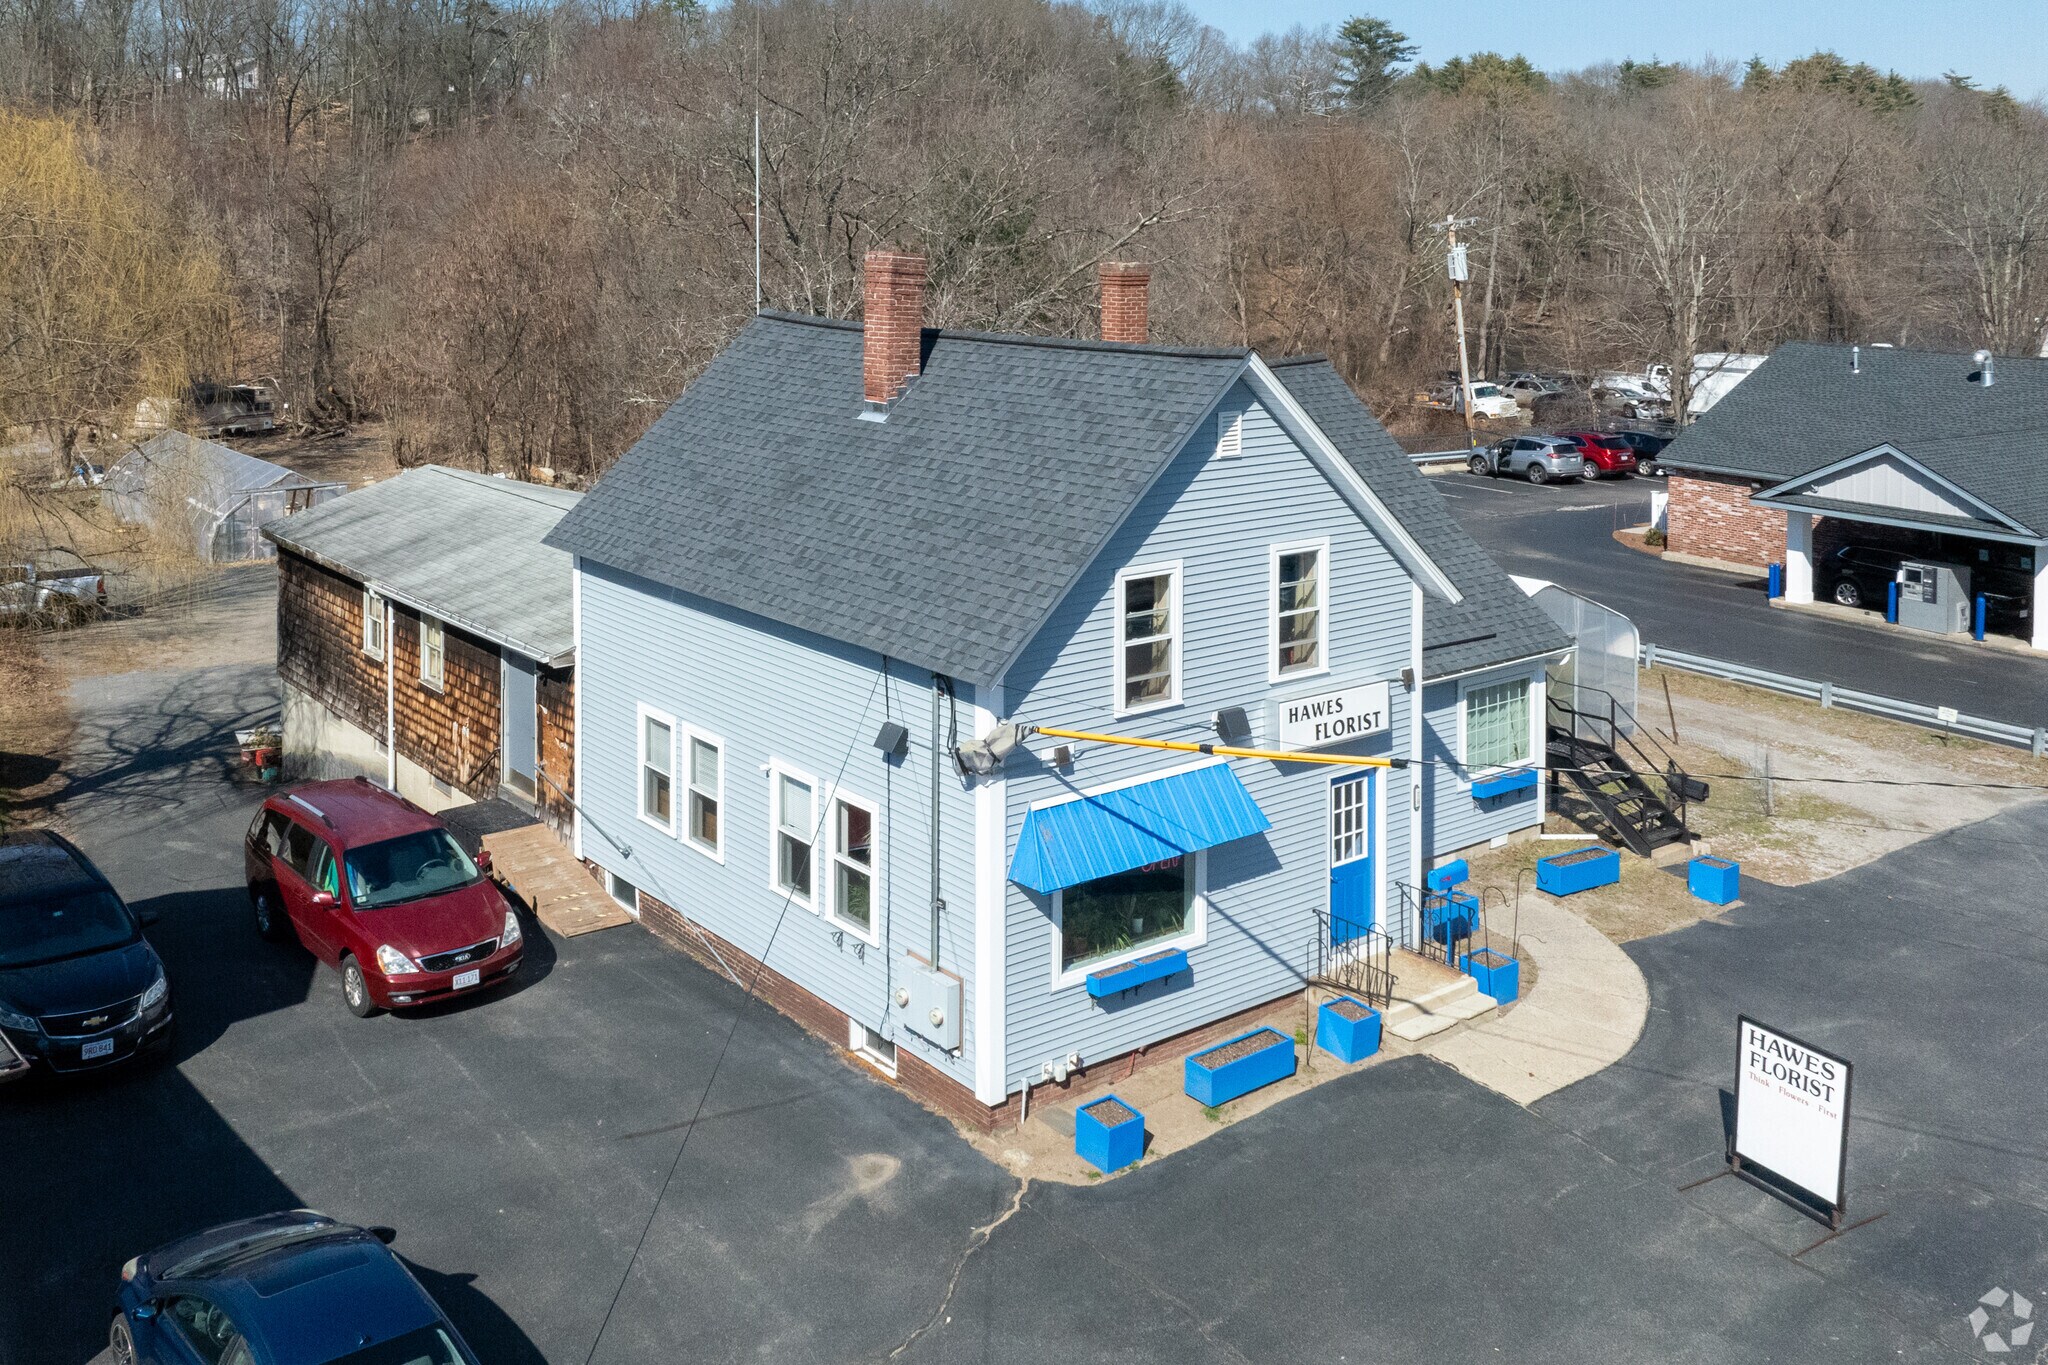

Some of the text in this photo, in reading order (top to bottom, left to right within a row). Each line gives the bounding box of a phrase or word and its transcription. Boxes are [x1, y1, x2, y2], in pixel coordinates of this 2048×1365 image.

[1289, 697, 1343, 724] HAWES
[1315, 711, 1381, 741] FLORIST
[1748, 1028, 1835, 1081] HAWES
[1749, 1050, 1835, 1103] FLORIST
[1748, 1071, 1838, 1119] Think Flowers First
